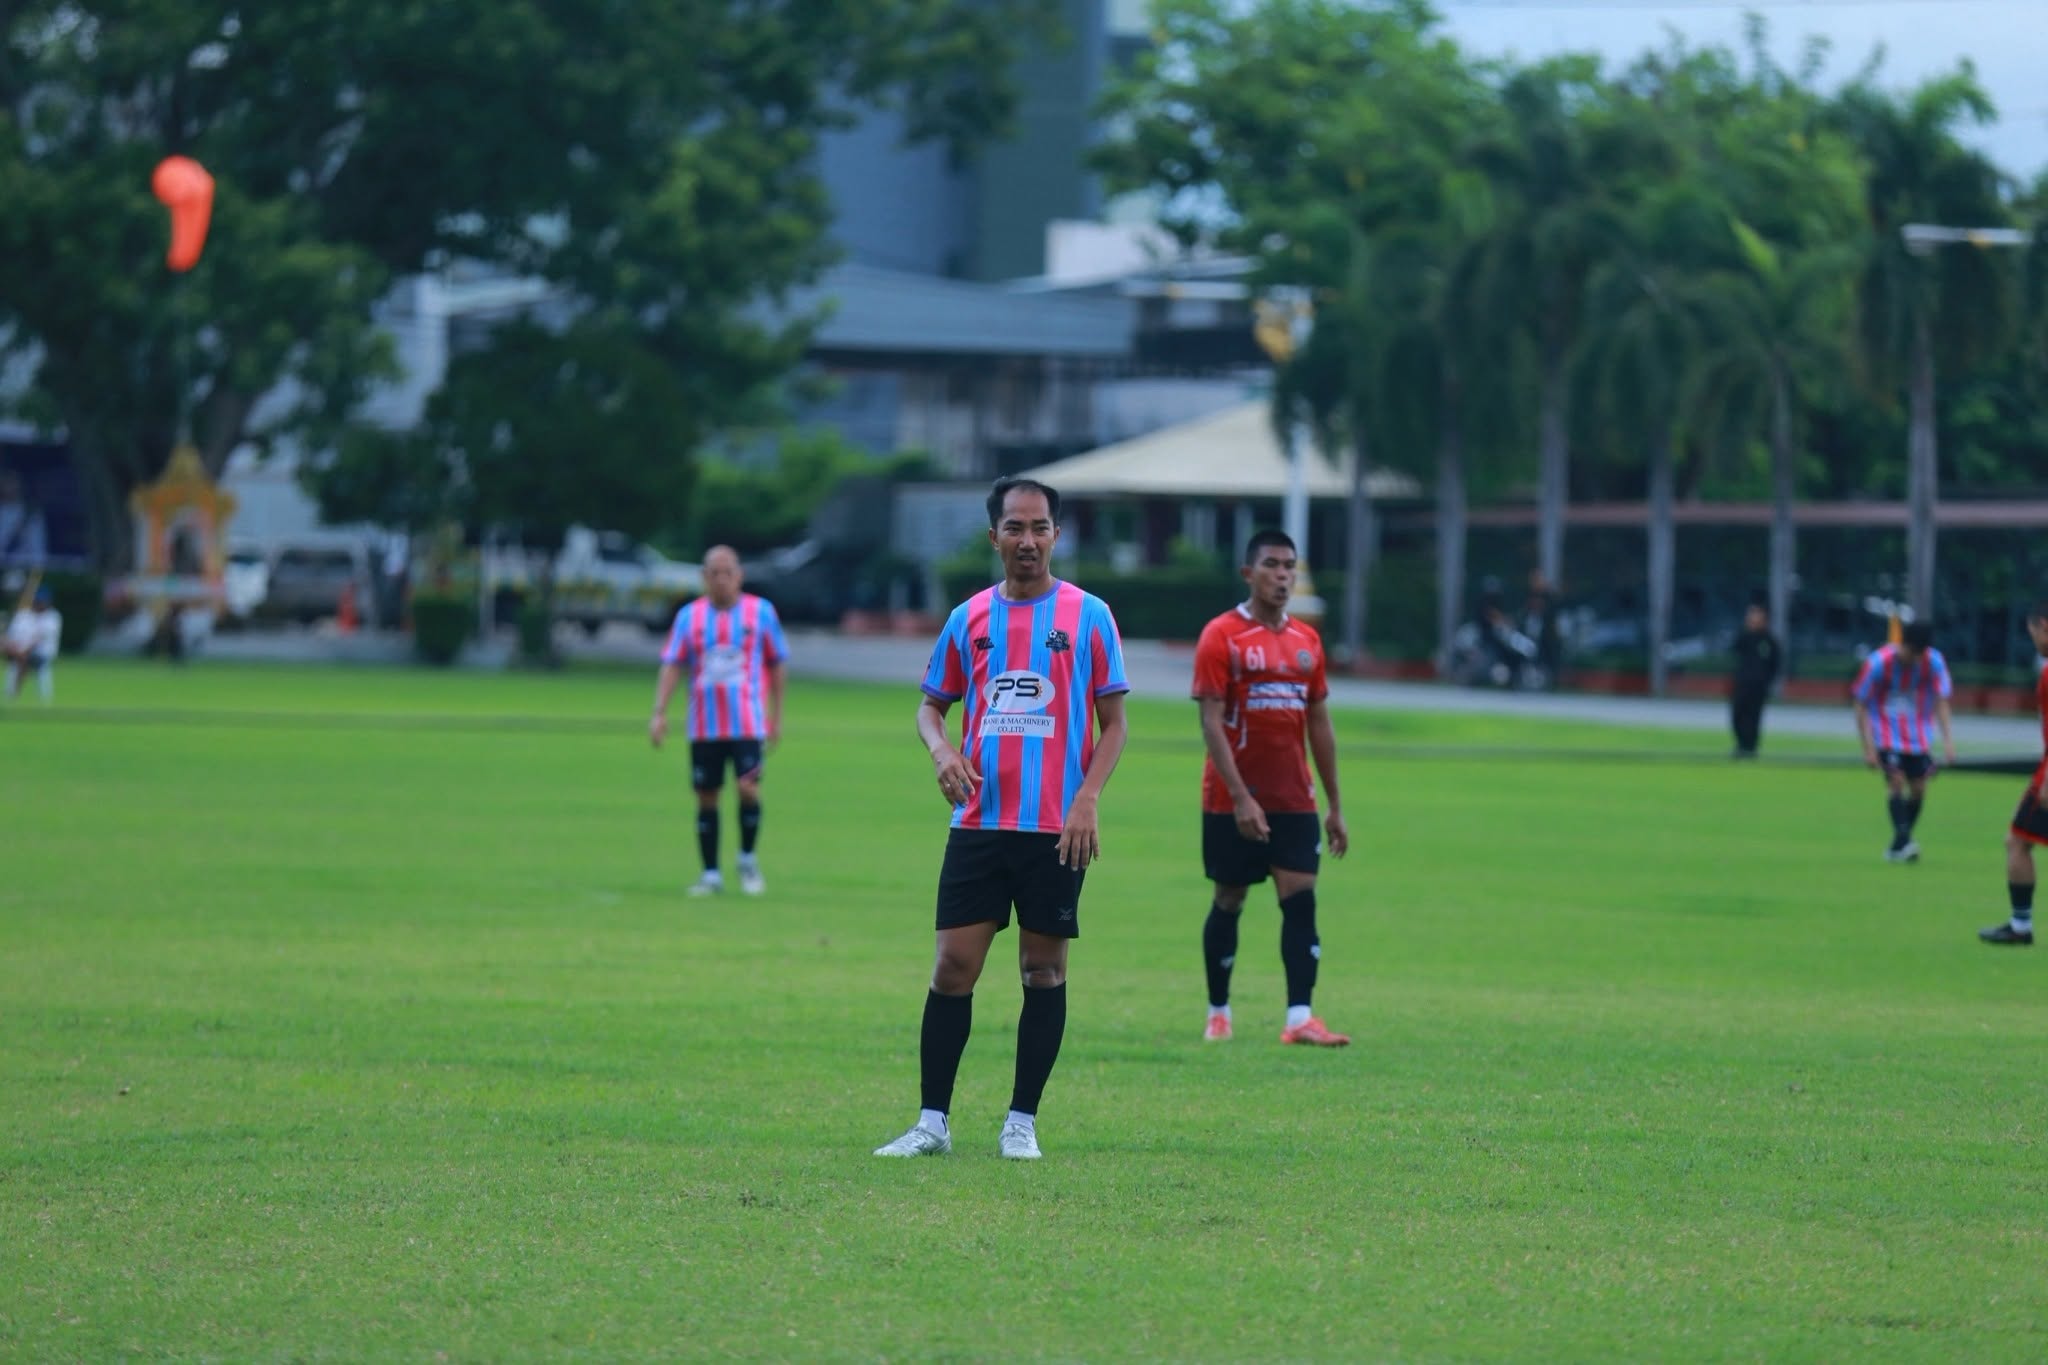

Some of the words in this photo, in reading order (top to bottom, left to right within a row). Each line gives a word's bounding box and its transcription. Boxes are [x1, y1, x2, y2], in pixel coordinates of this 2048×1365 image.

[1245, 645, 1266, 672] 61
[994, 677, 1040, 699] PS
[982, 717, 999, 726] RANE
[1000, 717, 1006, 725] &
[1007, 717, 1051, 726] MACHINERY
